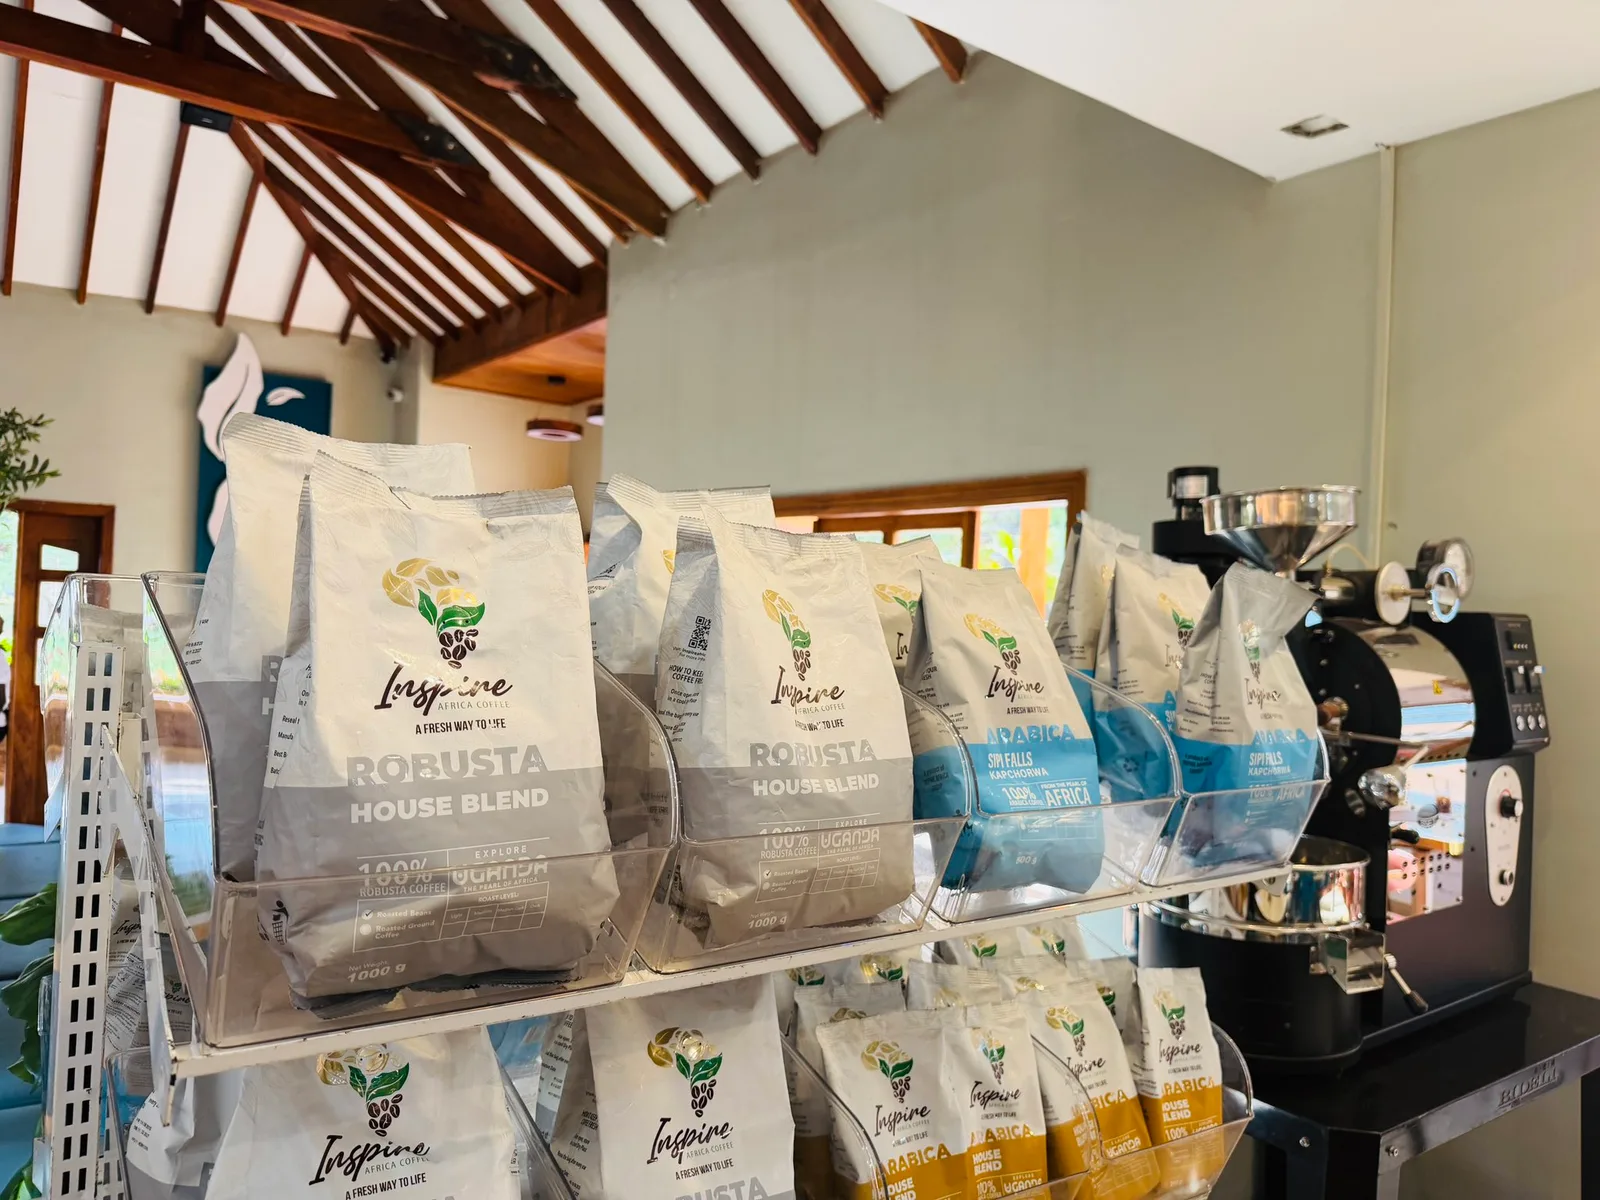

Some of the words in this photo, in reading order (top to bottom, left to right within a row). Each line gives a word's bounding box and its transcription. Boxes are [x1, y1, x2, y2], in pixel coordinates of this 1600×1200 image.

[669, 664, 684, 674] HOW
[684, 667, 692, 675] TO
[672, 672, 695, 684] COFFEE
[374, 661, 513, 717] Inspire
[984, 665, 1045, 703] Inspire
[437, 700, 474, 711] AFRICA
[476, 699, 511, 709] COFFEE
[820, 703, 846, 712] COFFEE
[1011, 706, 1026, 715] FRESH
[415, 724, 422, 735] A
[423, 722, 452, 734] FRESH
[454, 720, 474, 732] WAY
[475, 719, 487, 730] TO
[822, 720, 831, 730] TO
[831, 718, 845, 728] LIFE
[987, 724, 1076, 745] ARABICA
[750, 738, 878, 767] ROBUSTA
[1004, 751, 1033, 768] FALLS
[346, 744, 550, 787] ROBUSTA
[989, 767, 1050, 780] KAPCHORWA
[752, 777, 823, 796] HOUSE
[823, 773, 880, 793] BLEND
[1002, 785, 1037, 800] 100%
[351, 795, 453, 824] HOUSE
[461, 787, 550, 815] BLEND
[1044, 787, 1092, 807] AFRICA
[835, 818, 868, 829] EXPLORE
[760, 825, 809, 850] 100%
[820, 828, 880, 849] UGANDA
[475, 845, 528, 859] EXPLORE
[760, 849, 793, 859] ROBUSTA
[794, 846, 817, 856] COFFEE
[358, 857, 433, 888] 100%
[359, 886, 407, 898] ROBUSTA
[409, 882, 447, 894] COFFEE
[463, 885, 478, 893] THE
[478, 882, 501, 891] PEARL
[503, 880, 513, 888] OF
[513, 876, 538, 886] AFRICA
[478, 894, 498, 903] ROAST
[376, 909, 408, 918] Roasted
[409, 908, 432, 917] Beans
[375, 923, 407, 932] Roasted
[408, 919, 436, 930] Ground
[748, 915, 777, 929] 1000
[779, 915, 788, 925] g
[374, 931, 400, 940] Coffee
[347, 965, 391, 983] 1000
[394, 962, 407, 973] g
[970, 1081, 1021, 1110] Inspire
[874, 1105, 931, 1137] Inspire
[647, 1117, 734, 1165] Inspire
[686, 1147, 710, 1159] AFRICA
[710, 1141, 734, 1152] COFFEE
[972, 1148, 1002, 1166] HOUSE
[308, 1134, 431, 1186] Inspire
[364, 1161, 397, 1175] AFRICA
[974, 1160, 1003, 1176] BLEND
[675, 1171, 680, 1180] A
[680, 1166, 699, 1179] FRESH
[700, 1163, 713, 1175] WAY
[713, 1161, 721, 1171] TO
[721, 1158, 734, 1169] LIFE
[345, 1190, 351, 1200] A
[352, 1180, 378, 1199] FRESH
[378, 1178, 397, 1193] WAY
[398, 1176, 409, 1188] TO
[410, 1172, 427, 1185] LIFE
